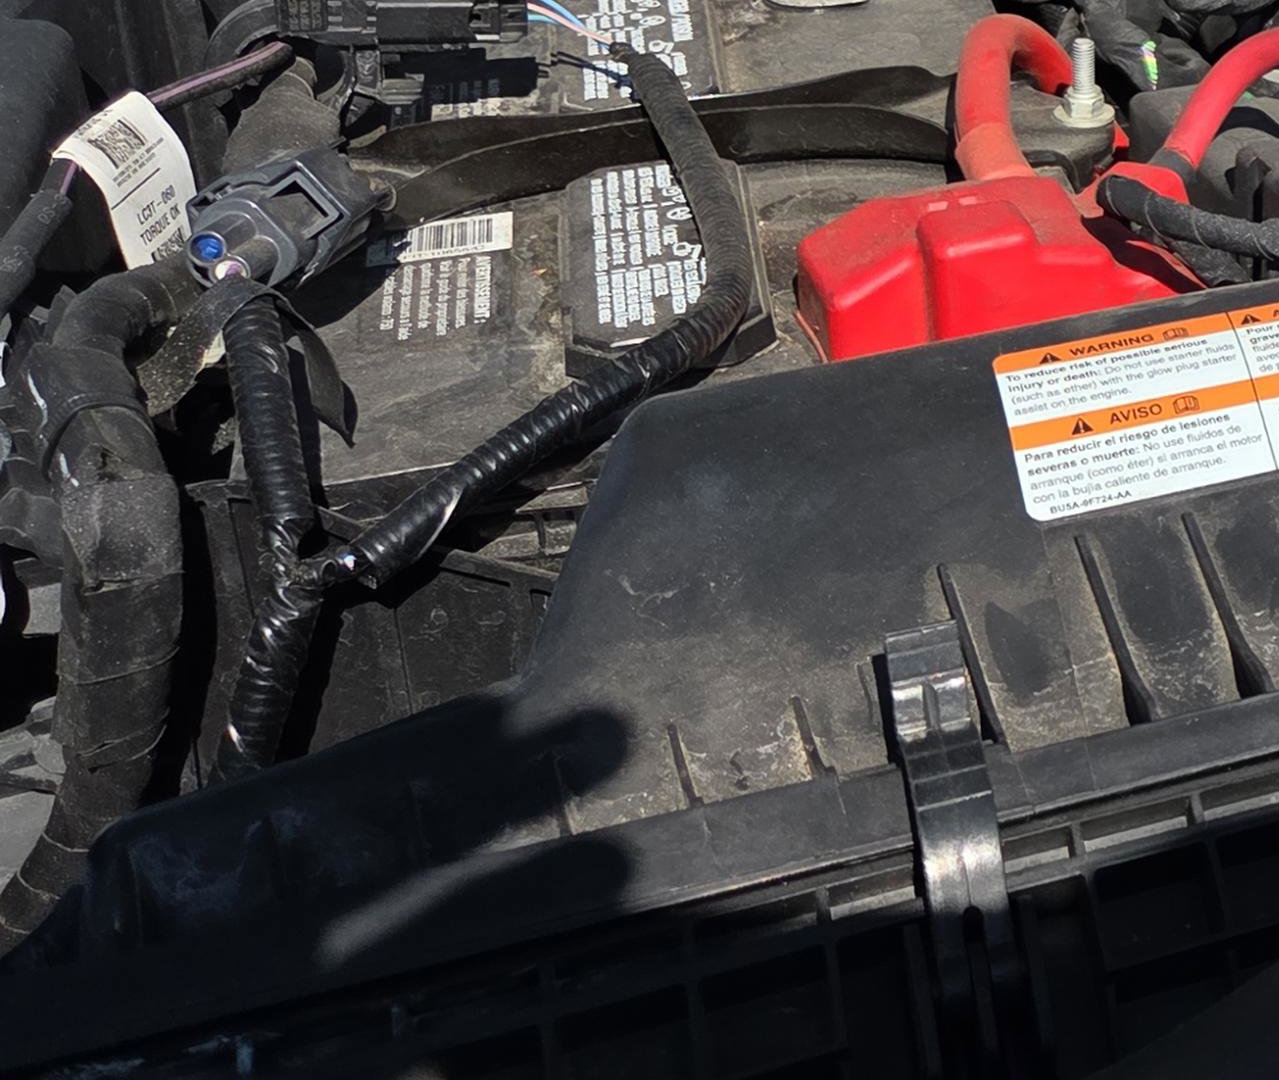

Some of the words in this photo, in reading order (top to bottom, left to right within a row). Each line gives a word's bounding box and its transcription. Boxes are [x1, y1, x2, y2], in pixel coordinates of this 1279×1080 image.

[140, 216, 171, 246] TORQUE
[169, 203, 182, 223] OK
[1069, 334, 1154, 356] WARNING
[1246, 325, 1273, 335] Pour
[1006, 374, 1021, 382] To
[1025, 363, 1067, 378] reduce
[1069, 360, 1092, 372] risk
[1095, 357, 1108, 366] of
[1111, 347, 1161, 364] possible
[1164, 338, 1208, 352] serious
[1012, 392, 1044, 405] (such
[1047, 388, 1061, 398] as
[1063, 381, 1098, 394] ether)
[1101, 374, 1123, 387] with
[1126, 372, 1144, 381] the
[1146, 367, 1172, 379] glow
[1175, 361, 1199, 373] plug
[1202, 353, 1237, 366] starter
[1047, 376, 1060, 385] or
[1105, 366, 1120, 374] Do
[1124, 361, 1142, 372] not
[1145, 357, 1165, 367] use
[1168, 350, 1203, 362] starter
[1206, 343, 1235, 354] fluids
[1259, 363, 1274, 373] de
[1014, 402, 1048, 416] assist
[1051, 400, 1066, 408] on
[1069, 394, 1087, 404] the
[1110, 403, 1162, 425] AVISO
[1025, 450, 1054, 462] Para
[1057, 439, 1102, 456] reducir
[1105, 436, 1116, 446] el
[1119, 427, 1158, 441] riesgo
[1161, 423, 1177, 434] de
[1179, 413, 1230, 430] lesiones
[1027, 460, 1077, 476] severas
[1081, 457, 1089, 465] o
[1143, 442, 1160, 452] No
[1163, 437, 1184, 448] use
[1187, 429, 1225, 442] fluidos
[1226, 424, 1242, 434] de
[1031, 473, 1084, 491] arranque
[1088, 464, 1124, 480] (como
[1157, 453, 1167, 462] si
[1170, 444, 1214, 460] arranca
[1216, 439, 1228, 450] el
[1230, 434, 1263, 448] motor
[1032, 494, 1056, 504] con
[1058, 489, 1070, 499] la
[1104, 471, 1151, 489] caliente
[1153, 466, 1169, 477] de
